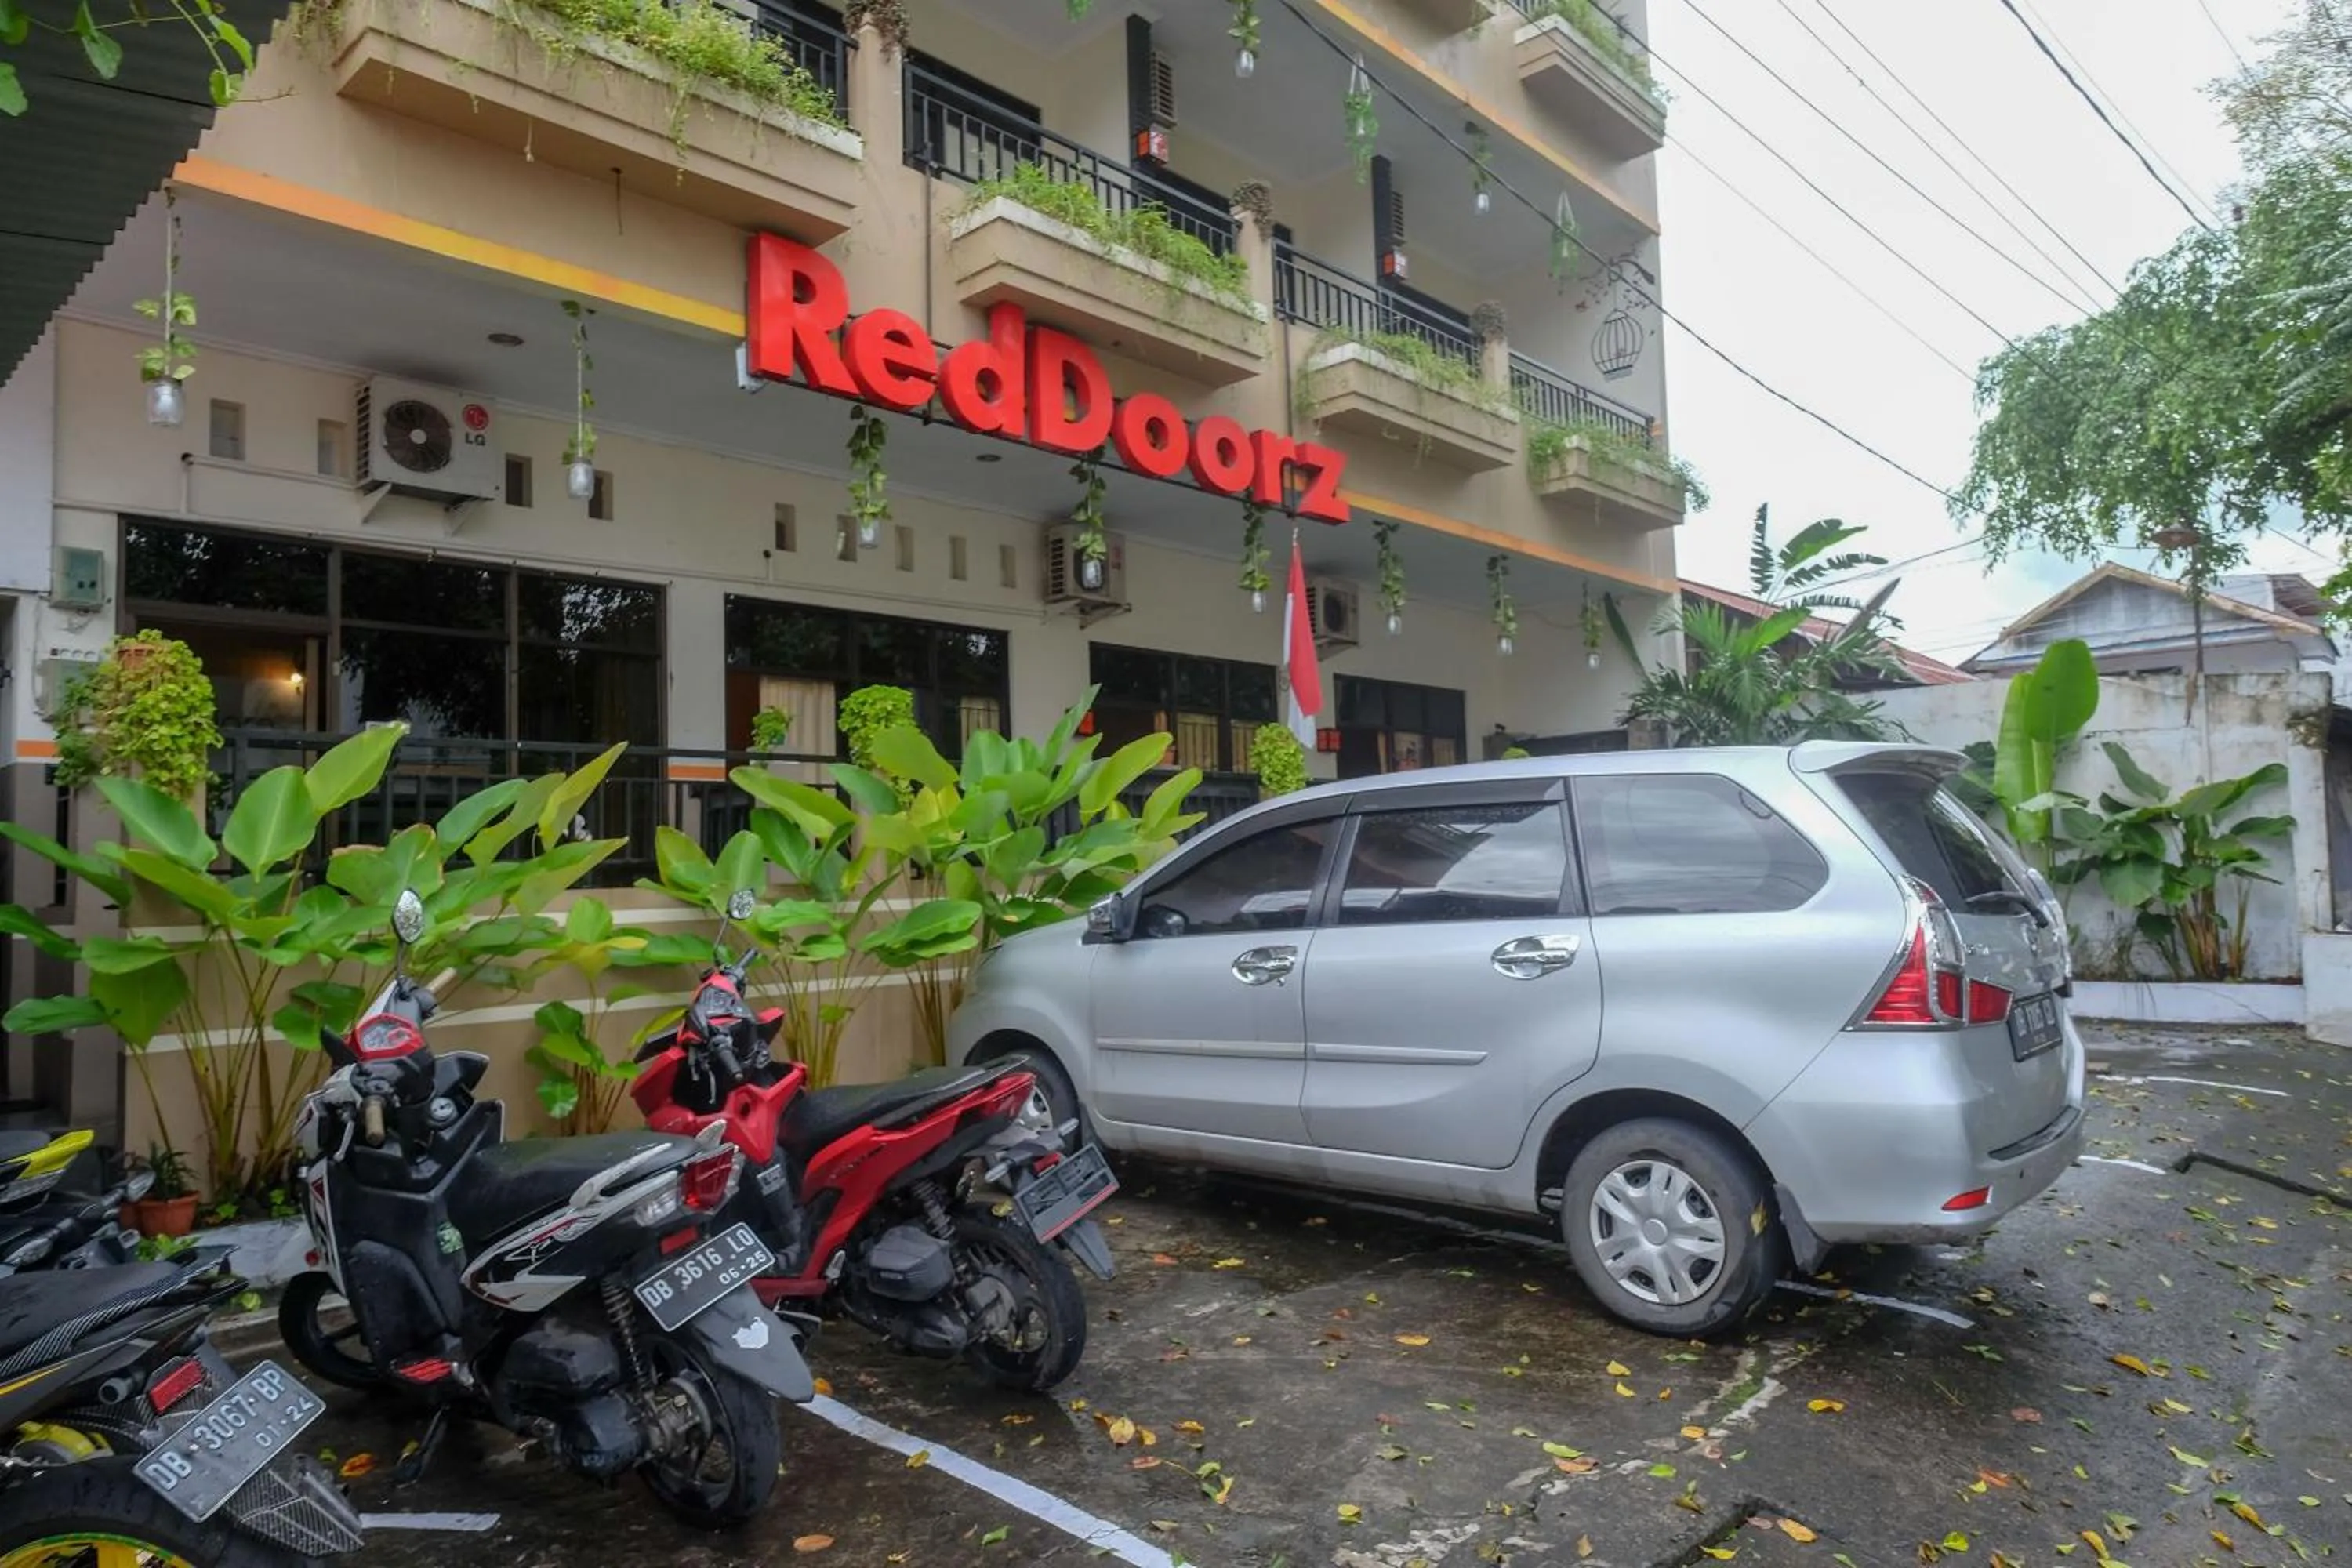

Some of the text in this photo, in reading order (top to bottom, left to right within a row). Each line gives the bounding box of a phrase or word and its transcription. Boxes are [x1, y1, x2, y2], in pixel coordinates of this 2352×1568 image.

[746, 230, 1351, 525] RedDoorz
[465, 432, 485, 446] LG
[641, 1279, 674, 1308] DB
[674, 1247, 723, 1286] 3616
[143, 1368, 285, 1490] DB 3067 BP
